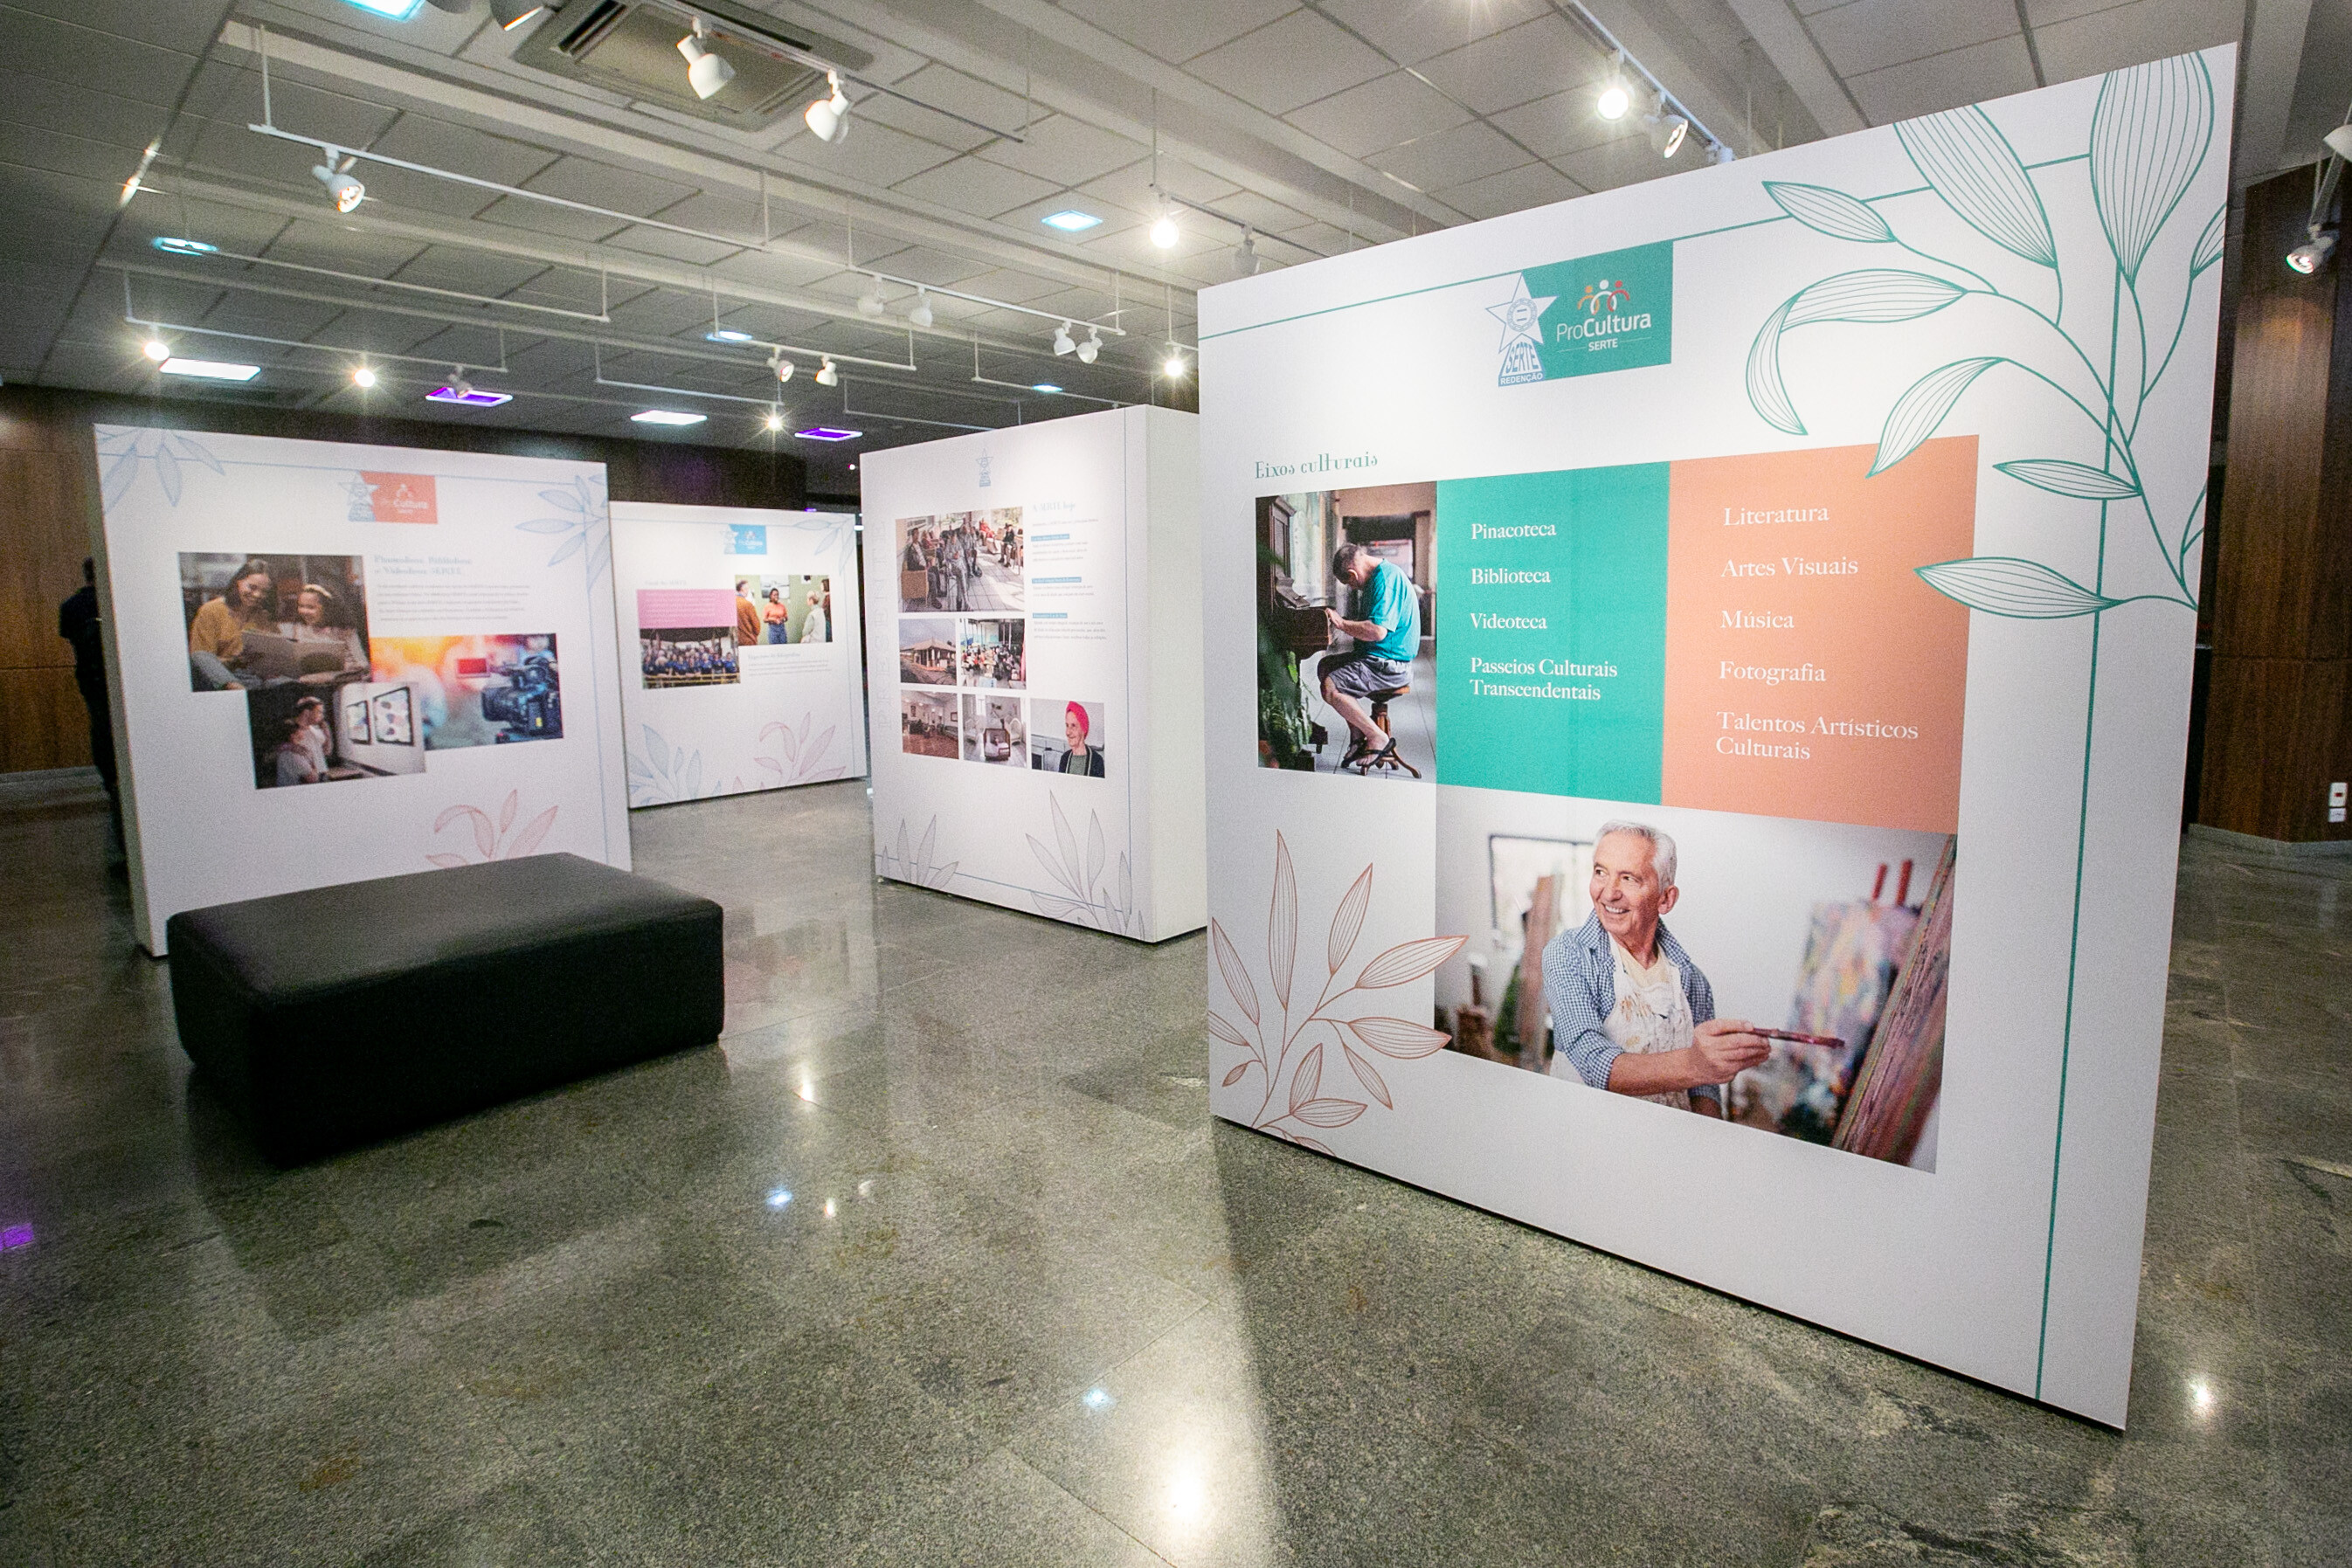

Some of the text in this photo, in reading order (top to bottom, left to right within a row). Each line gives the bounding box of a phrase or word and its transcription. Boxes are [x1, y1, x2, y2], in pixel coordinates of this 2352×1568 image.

[1556, 313, 1652, 342] ProCultura
[1588, 338, 1619, 352] SERTE
[1505, 342, 1539, 374] SERTE
[1500, 373, 1544, 385] REDENÇÃO
[1255, 451, 1378, 479] Eixos culturais
[1723, 507, 1830, 526] Literatura
[1470, 523, 1557, 540] Pinacoteca
[1470, 568, 1552, 585] Biblioteca
[1720, 556, 1859, 577] Artes Visuais
[1470, 612, 1548, 630] Videoteca
[1719, 610, 1795, 629] Música
[1470, 657, 1618, 678] Passeios Culturais
[1719, 660, 1826, 686] Fotografia
[1470, 679, 1601, 701] Transcendentais
[1716, 711, 1920, 740] Talentos Artísticos
[1715, 736, 1811, 760] Culturais
